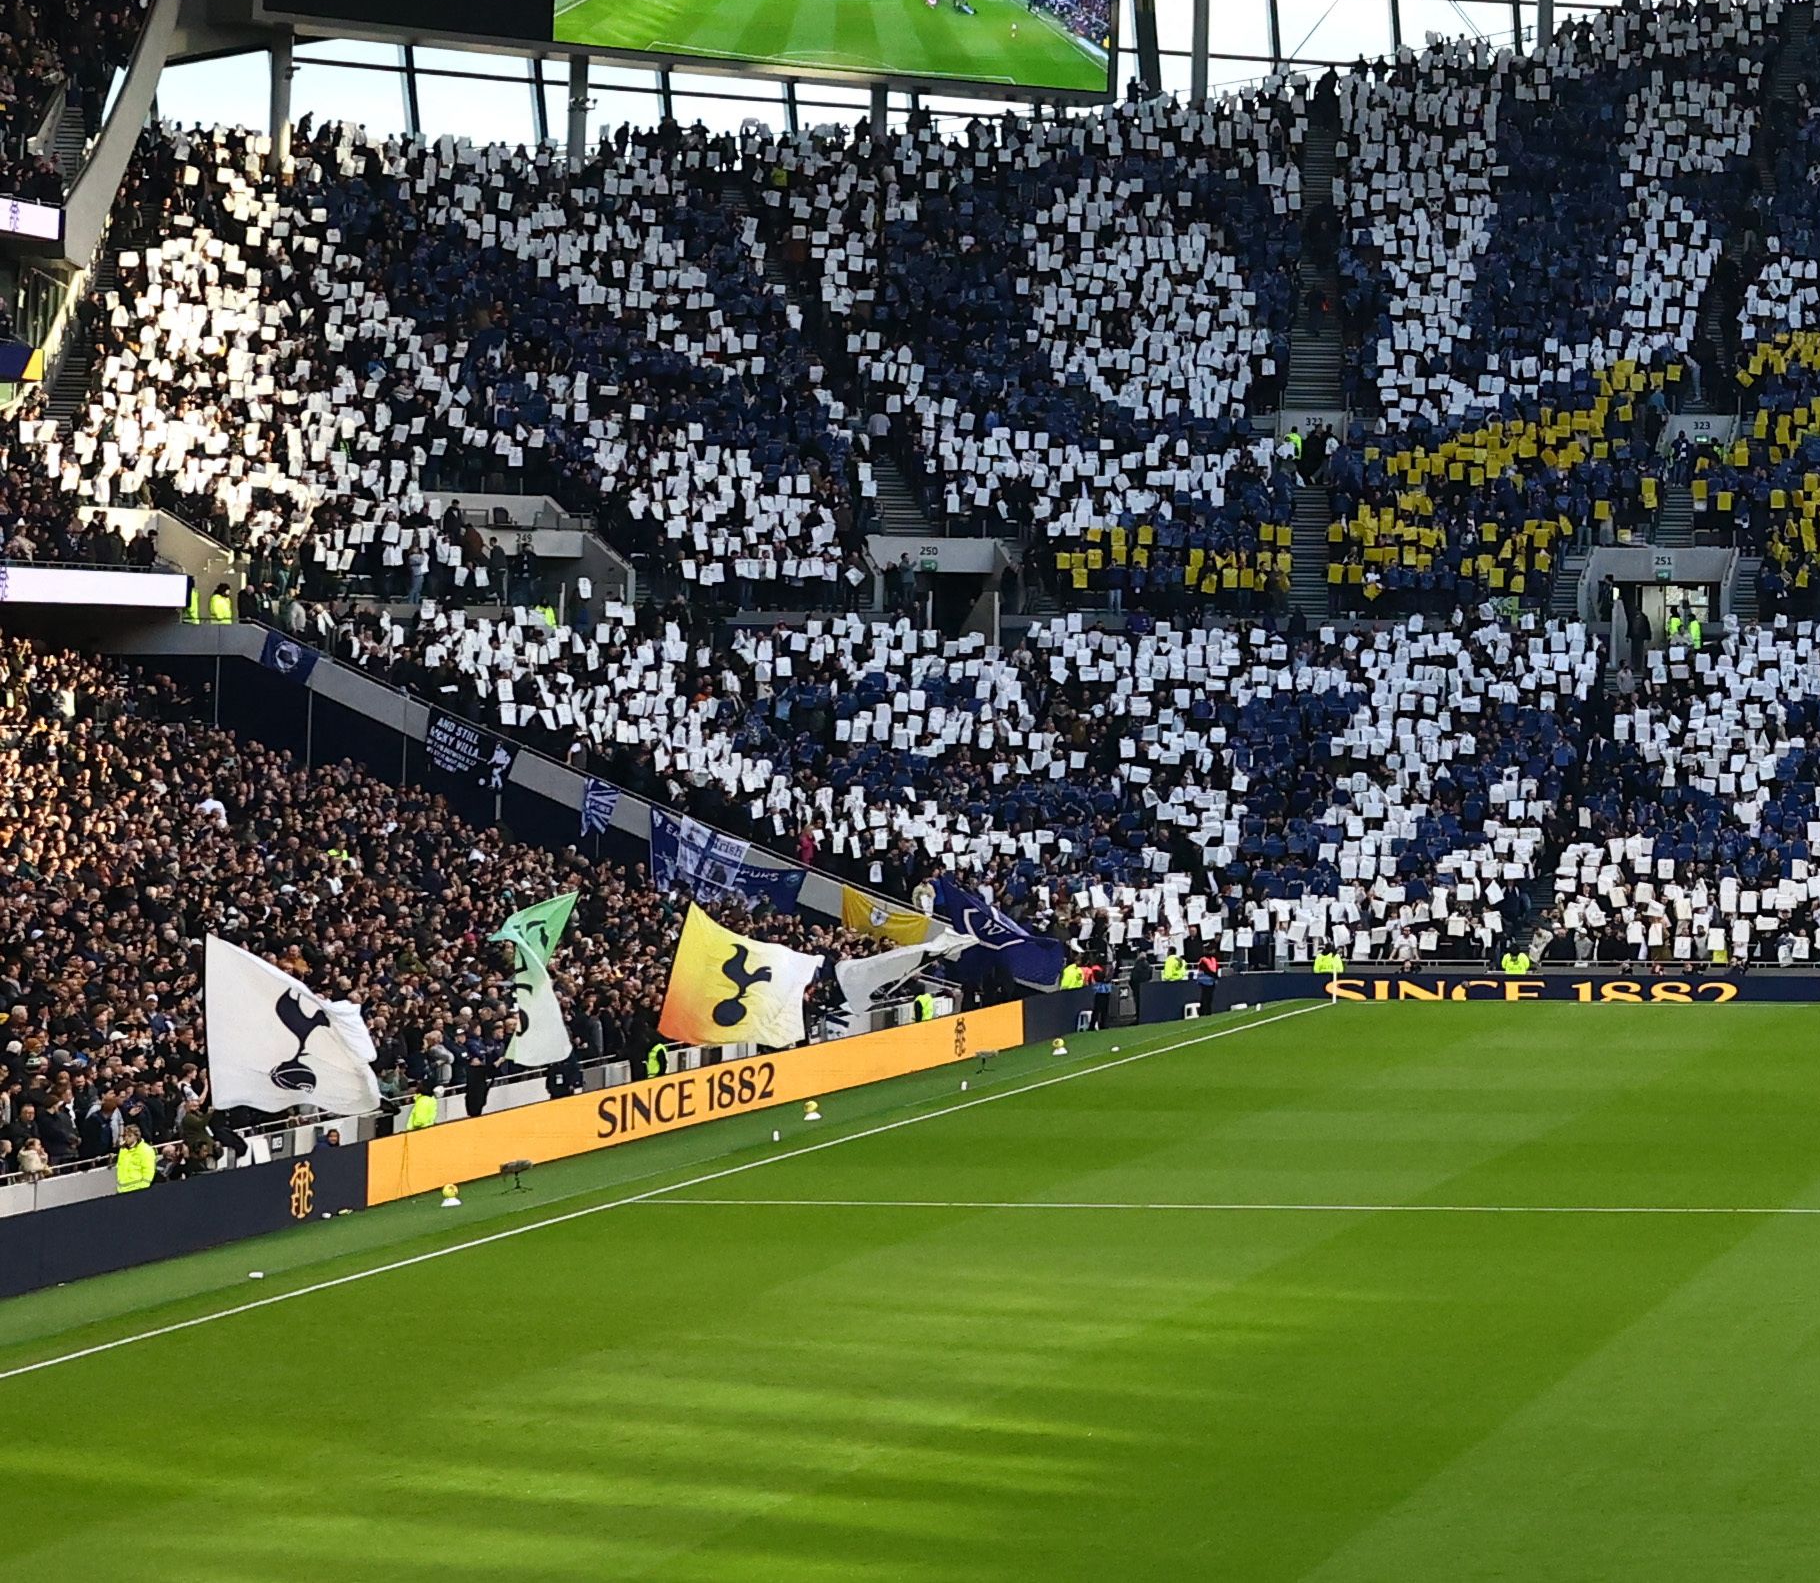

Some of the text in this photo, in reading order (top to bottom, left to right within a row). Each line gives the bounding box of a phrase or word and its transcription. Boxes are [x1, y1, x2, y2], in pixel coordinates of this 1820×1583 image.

[1694, 421, 1711, 430] 323
[516, 533, 533, 543] 249
[920, 546, 938, 556] 250
[1655, 556, 1672, 565] 251
[437, 717, 479, 745] AND STILL
[597, 1062, 775, 1139] SINCE 1882
